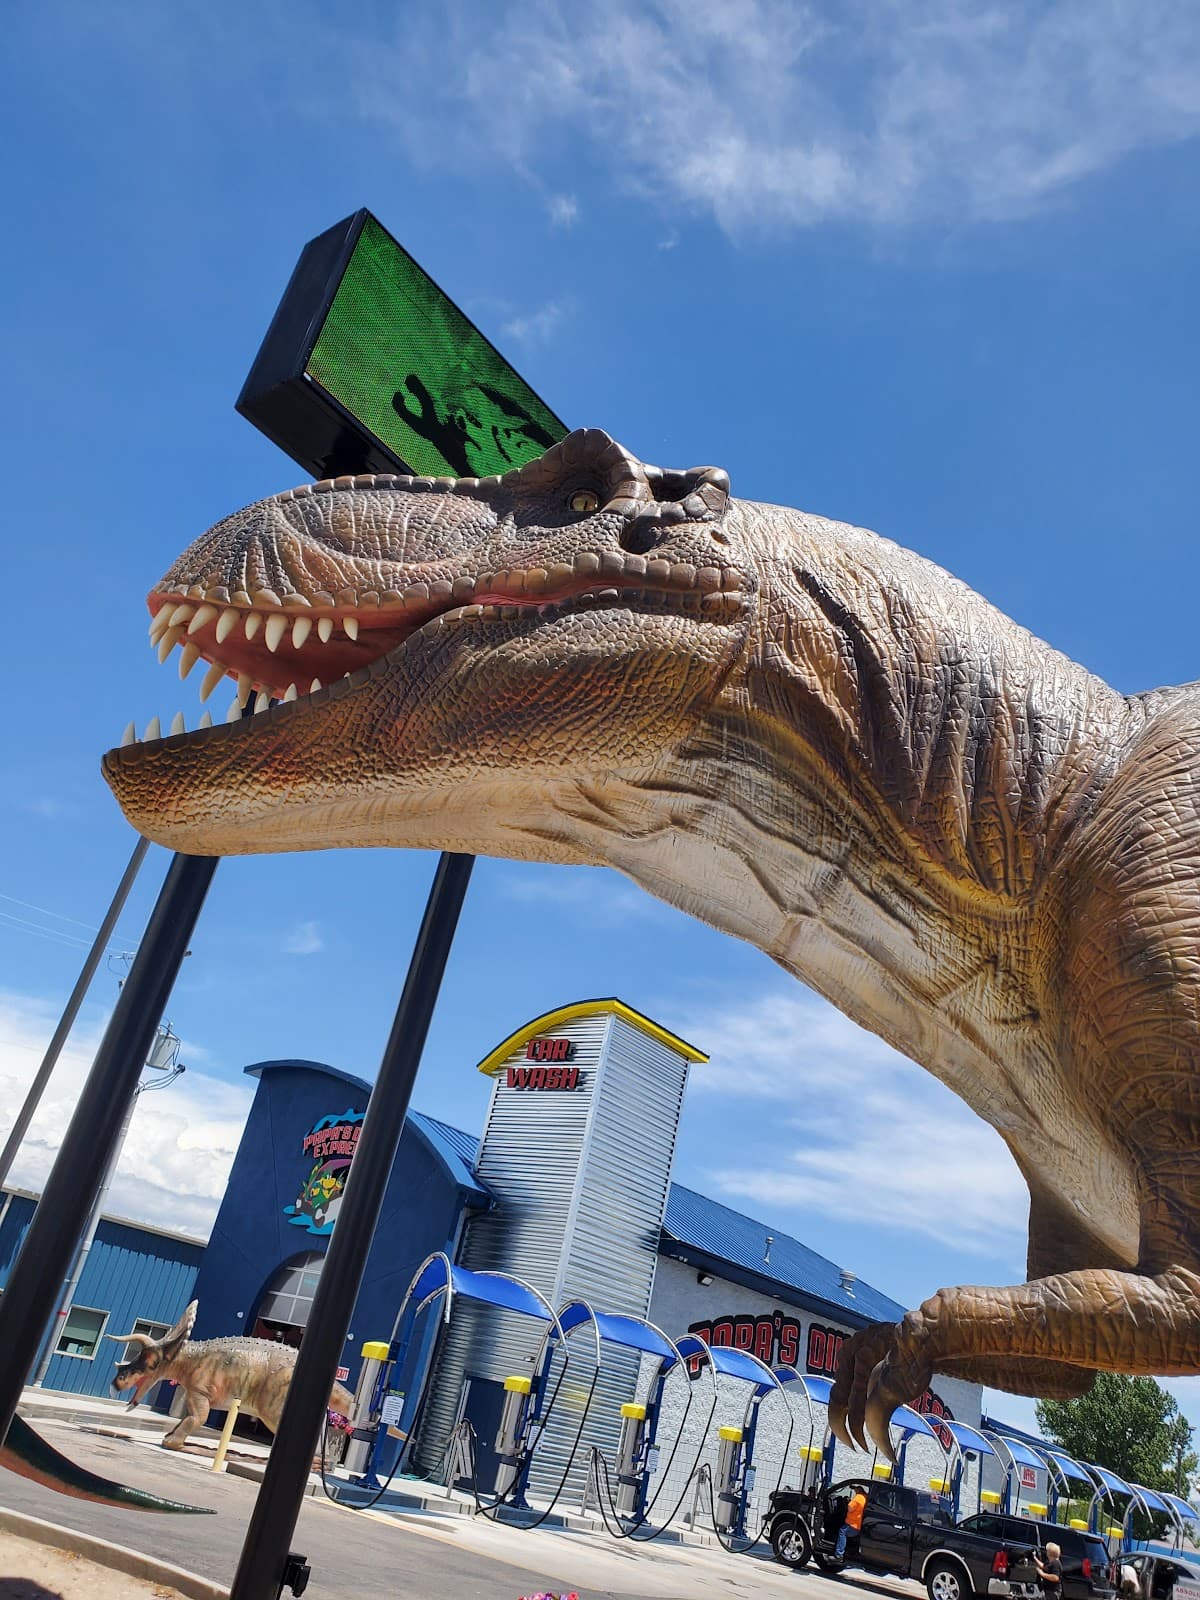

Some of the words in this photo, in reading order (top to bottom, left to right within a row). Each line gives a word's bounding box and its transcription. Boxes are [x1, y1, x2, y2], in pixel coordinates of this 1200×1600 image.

[527, 1039, 569, 1060] CAR
[506, 1068, 579, 1089] WASH
[303, 1126, 353, 1150] PAPA'S
